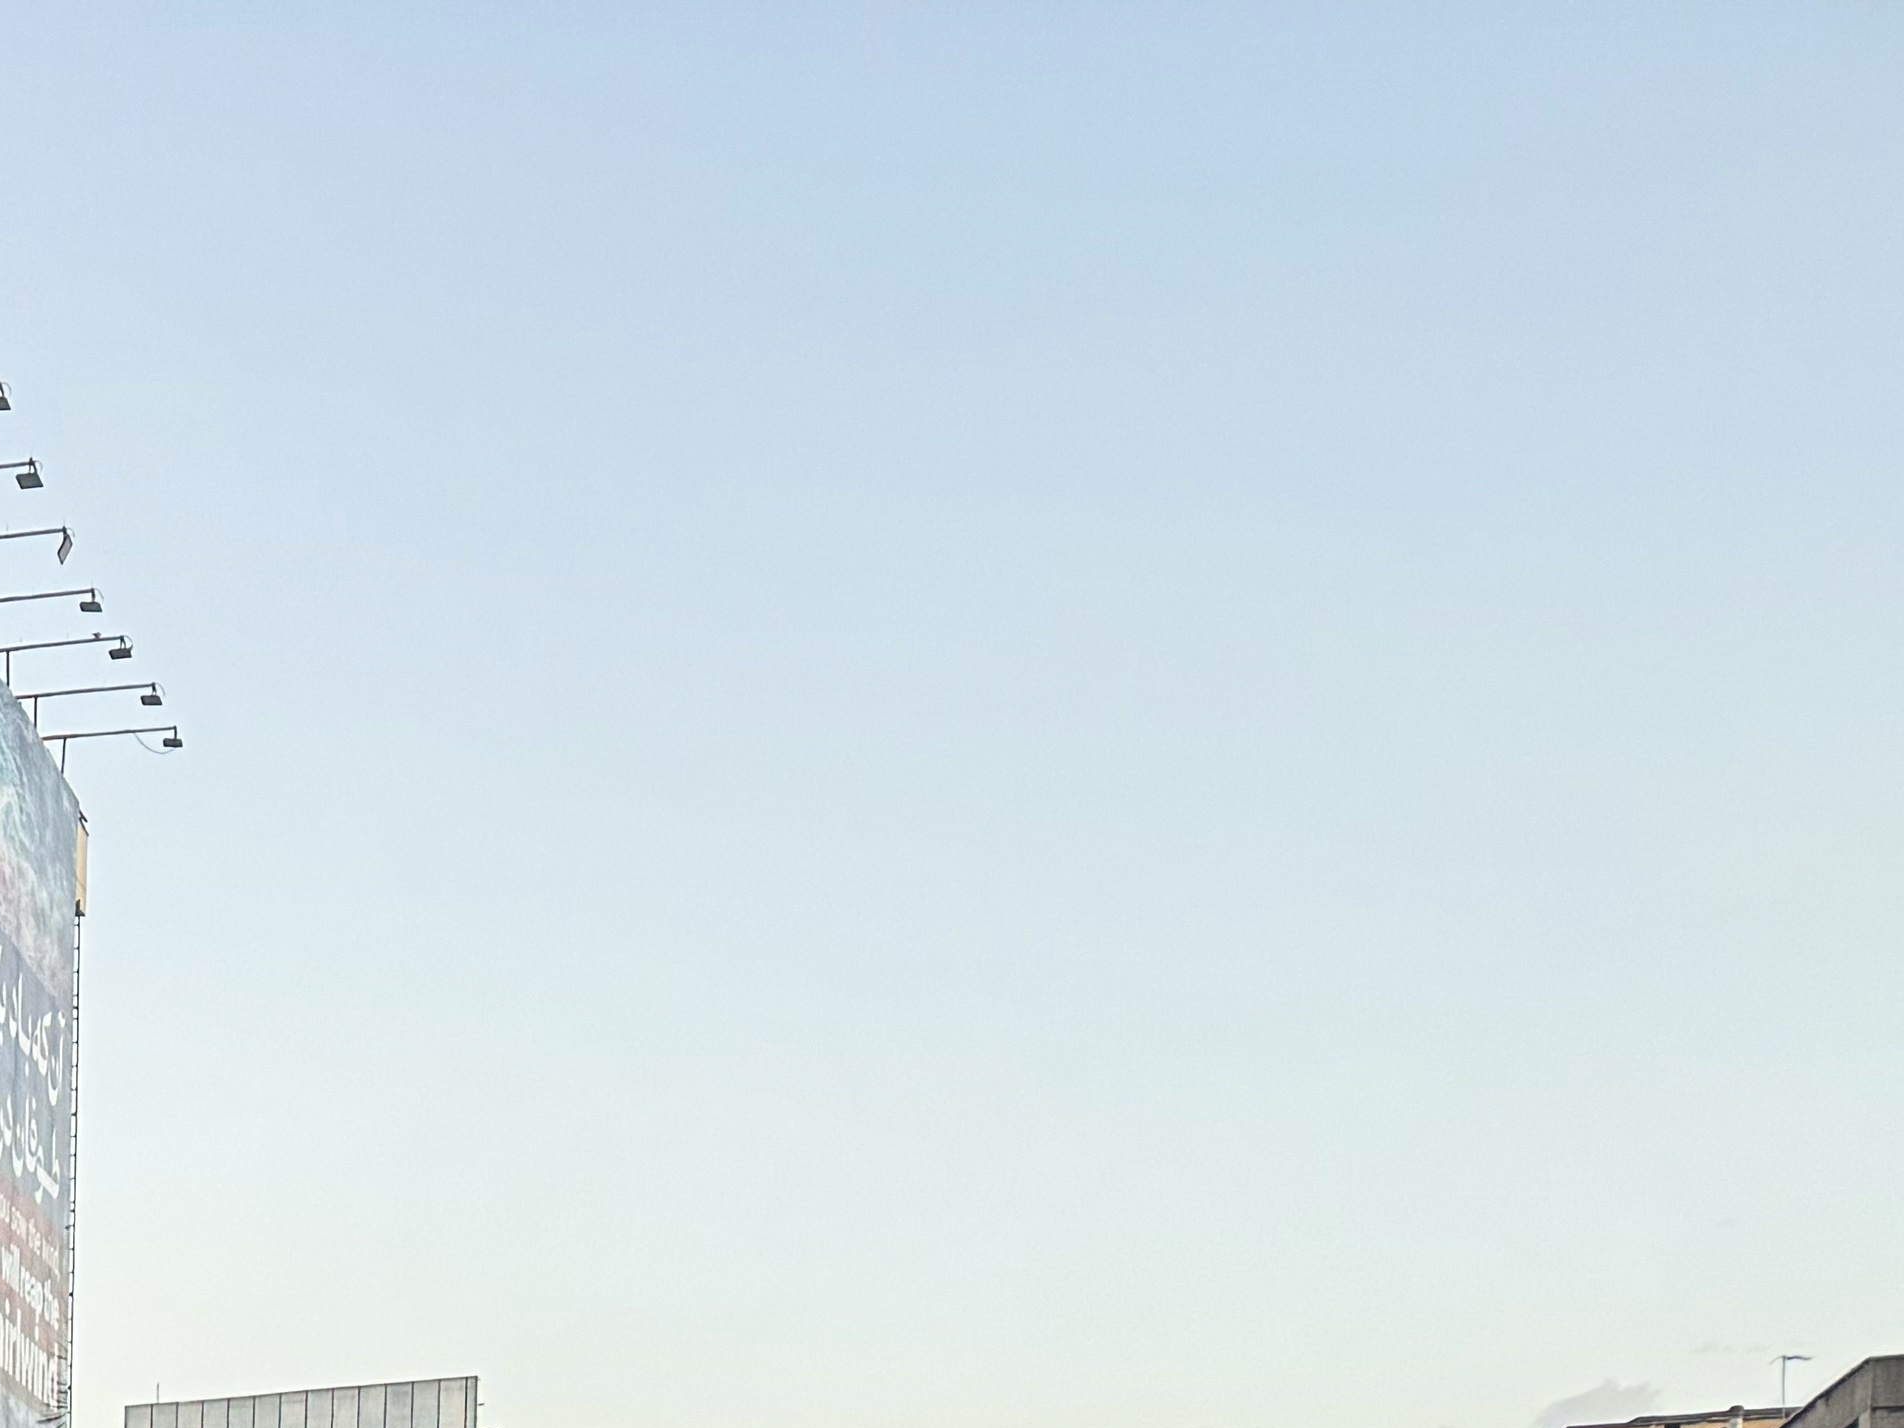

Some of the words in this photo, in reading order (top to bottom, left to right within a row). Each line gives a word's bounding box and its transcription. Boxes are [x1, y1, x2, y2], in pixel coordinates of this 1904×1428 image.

[1, 1243, 20, 1293] will
[20, 1264, 44, 1324] reap
[44, 1278, 60, 1331] the
